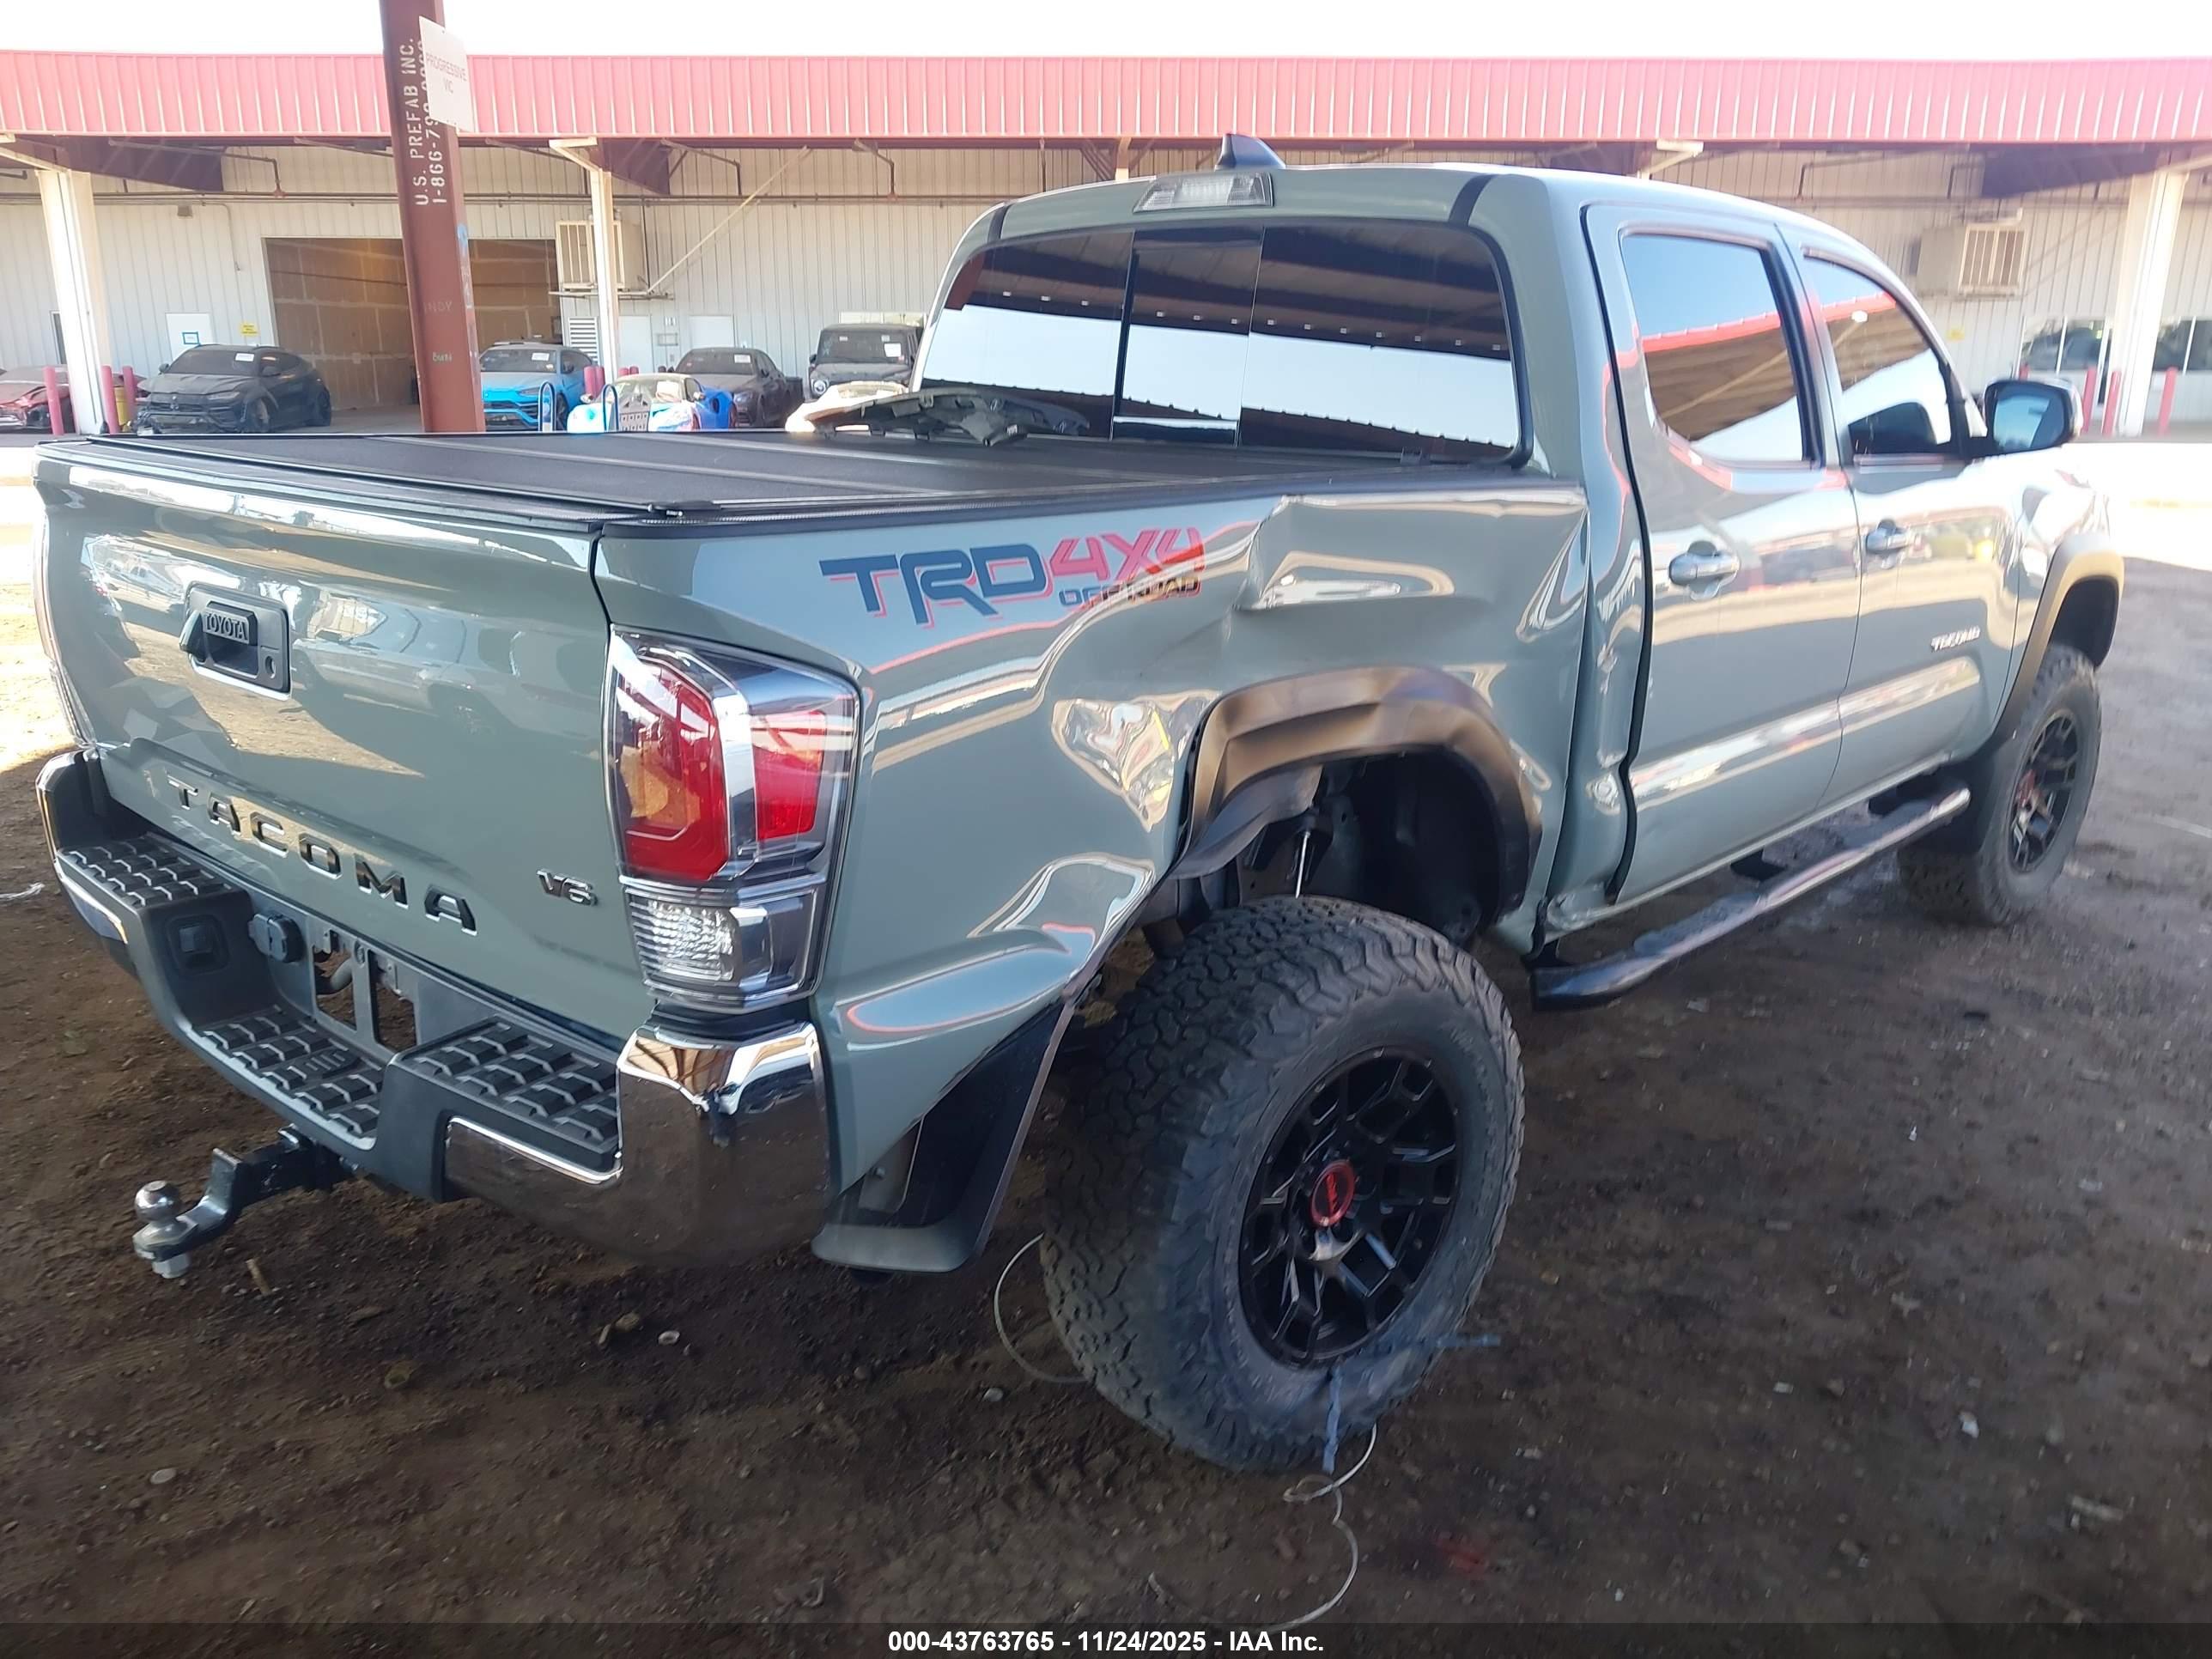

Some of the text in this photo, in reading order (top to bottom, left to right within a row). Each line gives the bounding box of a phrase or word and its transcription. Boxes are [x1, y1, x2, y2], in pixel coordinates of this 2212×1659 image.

[399, 38, 416, 75] INC.
[404, 84, 425, 159] PREFAB
[819, 543, 1054, 629] TRD
[205, 612, 248, 641] TOYOTA
[167, 774, 478, 937] TACOMA
[535, 868, 599, 907] V6
